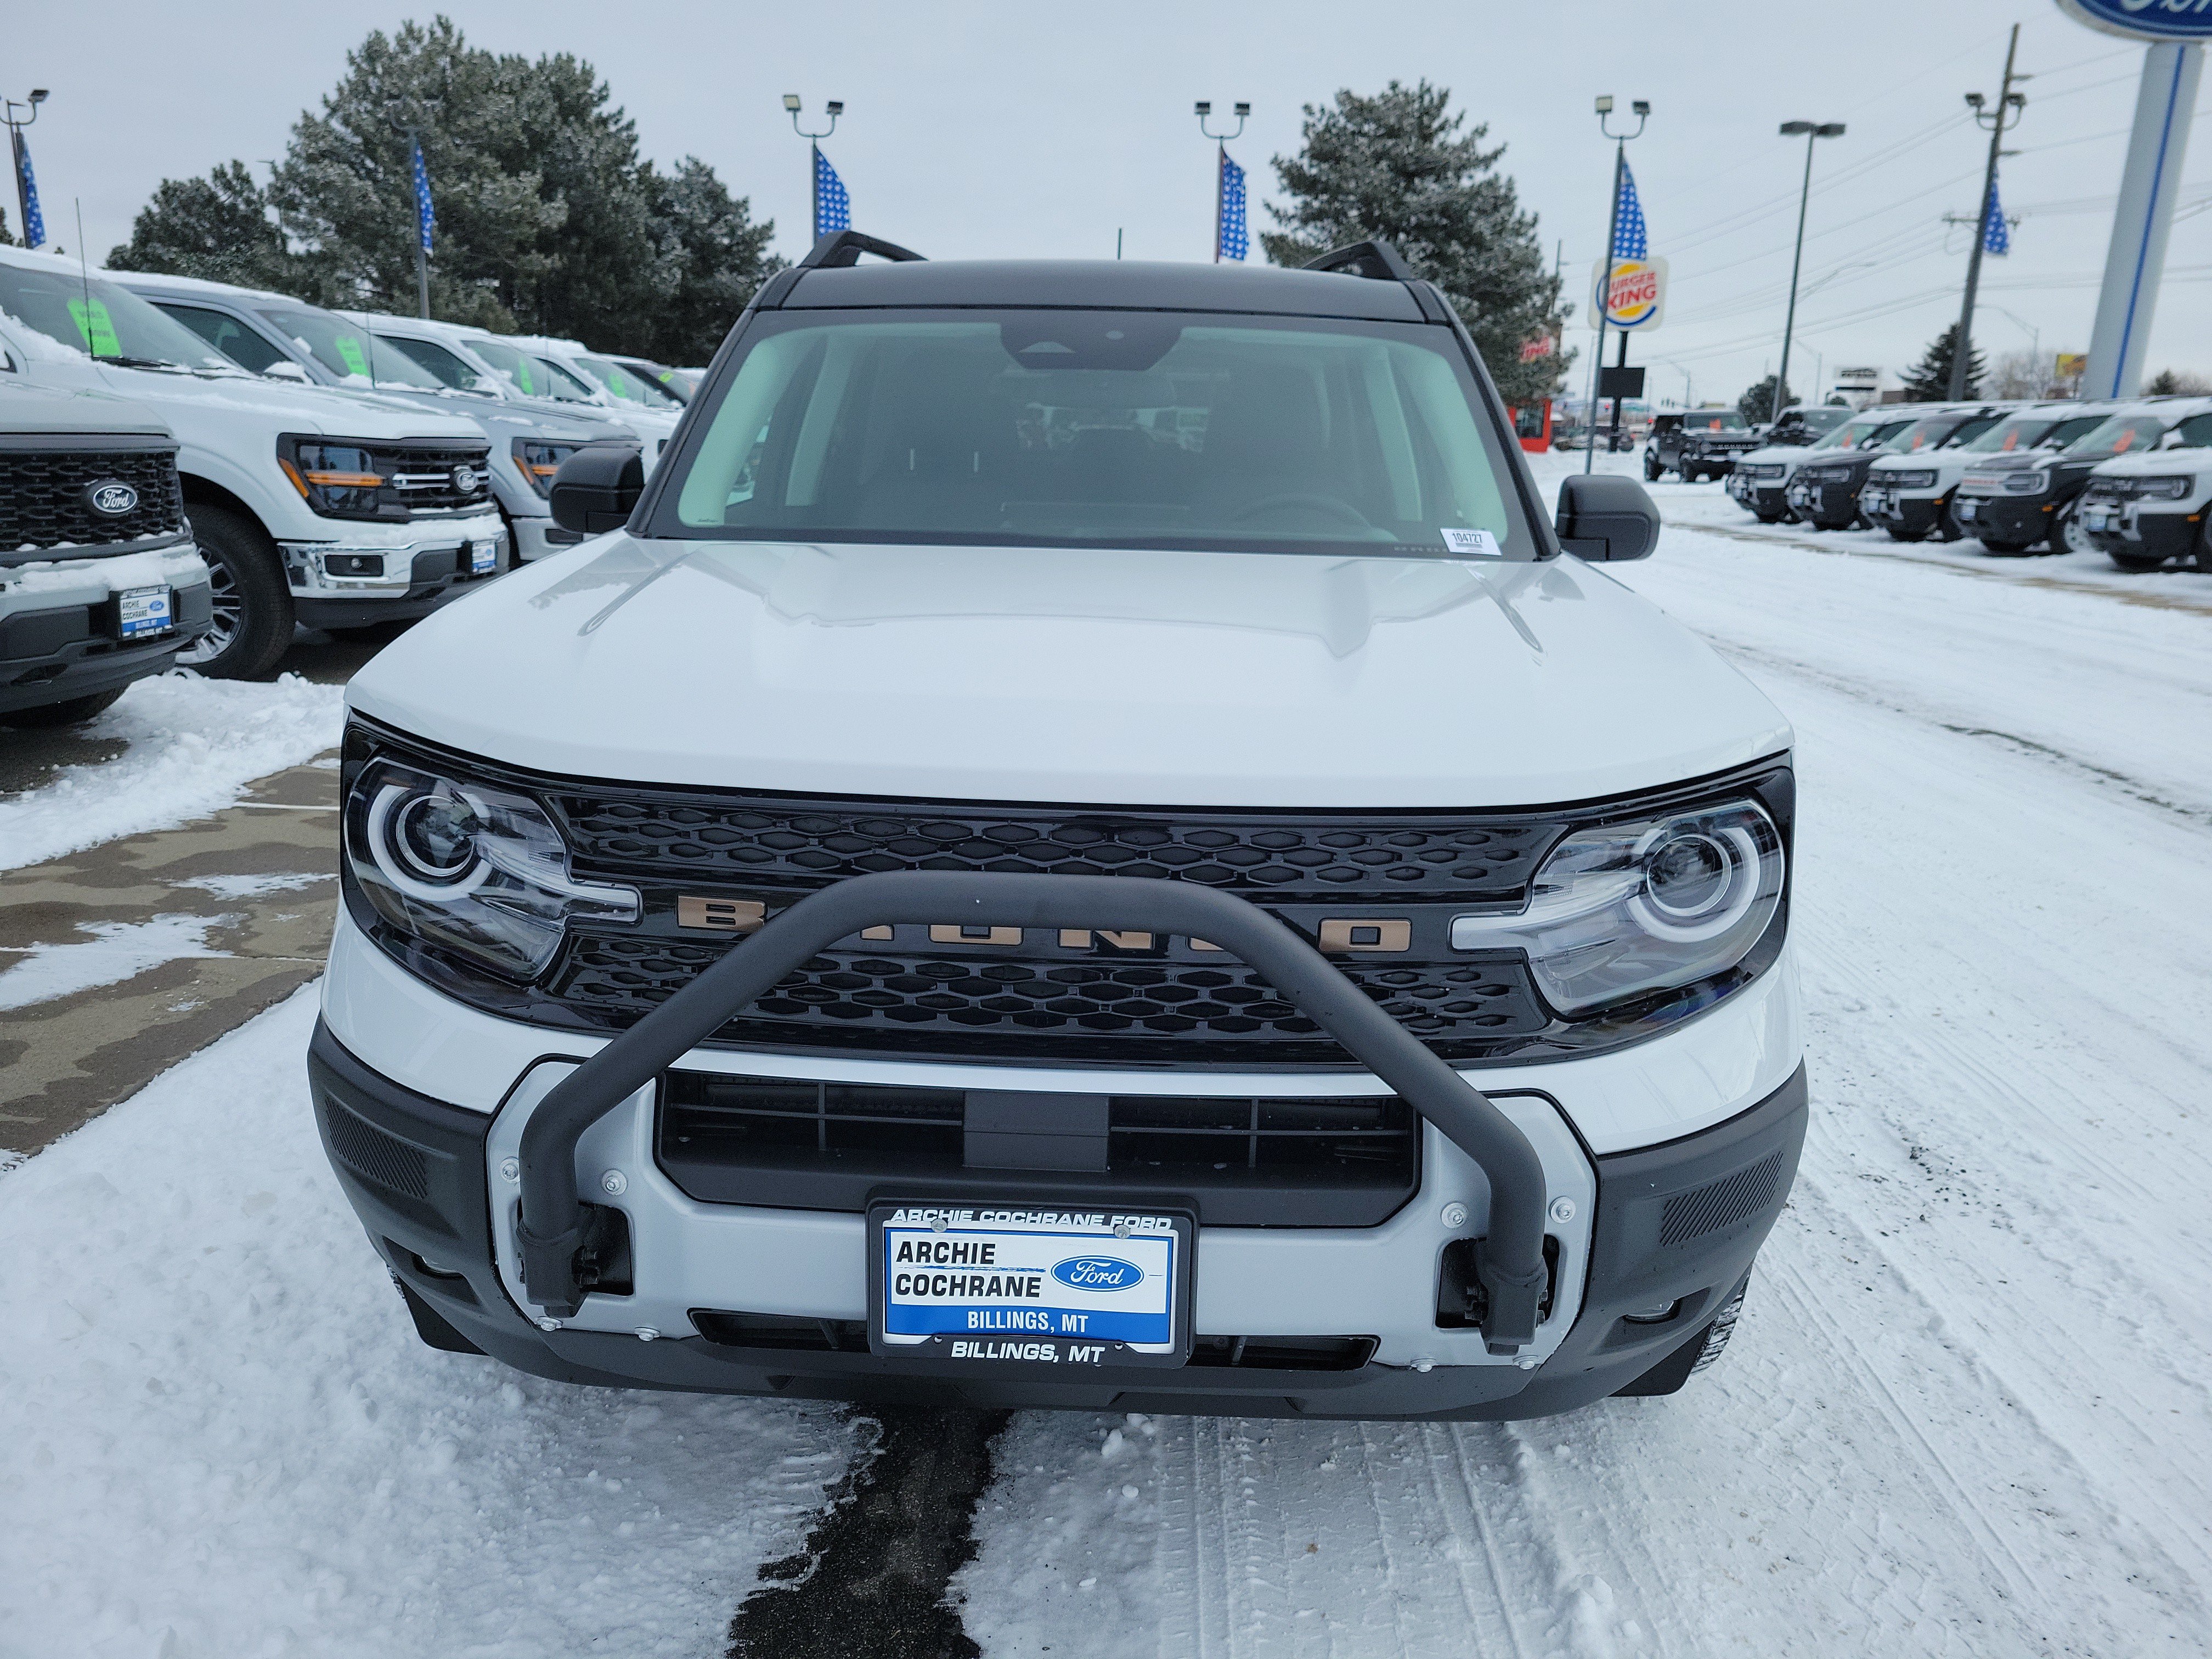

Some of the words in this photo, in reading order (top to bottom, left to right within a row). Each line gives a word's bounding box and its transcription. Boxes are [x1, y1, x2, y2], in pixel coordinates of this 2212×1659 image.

[103, 488, 129, 508] Ford
[1452, 532, 1482, 543] 104727
[122, 599, 140, 610] ARCHIE
[123, 610, 148, 620] COCHRANE
[891, 1209, 972, 1223] ARCHIE
[980, 1211, 1104, 1227] COCHRANE
[1109, 1215, 1172, 1231] FORD
[896, 1241, 996, 1265] ARCHIE
[1070, 1260, 1123, 1284] Ford
[895, 1273, 1041, 1298] COCHRANE
[968, 1311, 1054, 1333] BILLINGS,
[1062, 1314, 1088, 1333] MT
[951, 1341, 1059, 1363] BILLINGS,
[1068, 1345, 1105, 1363] MT
